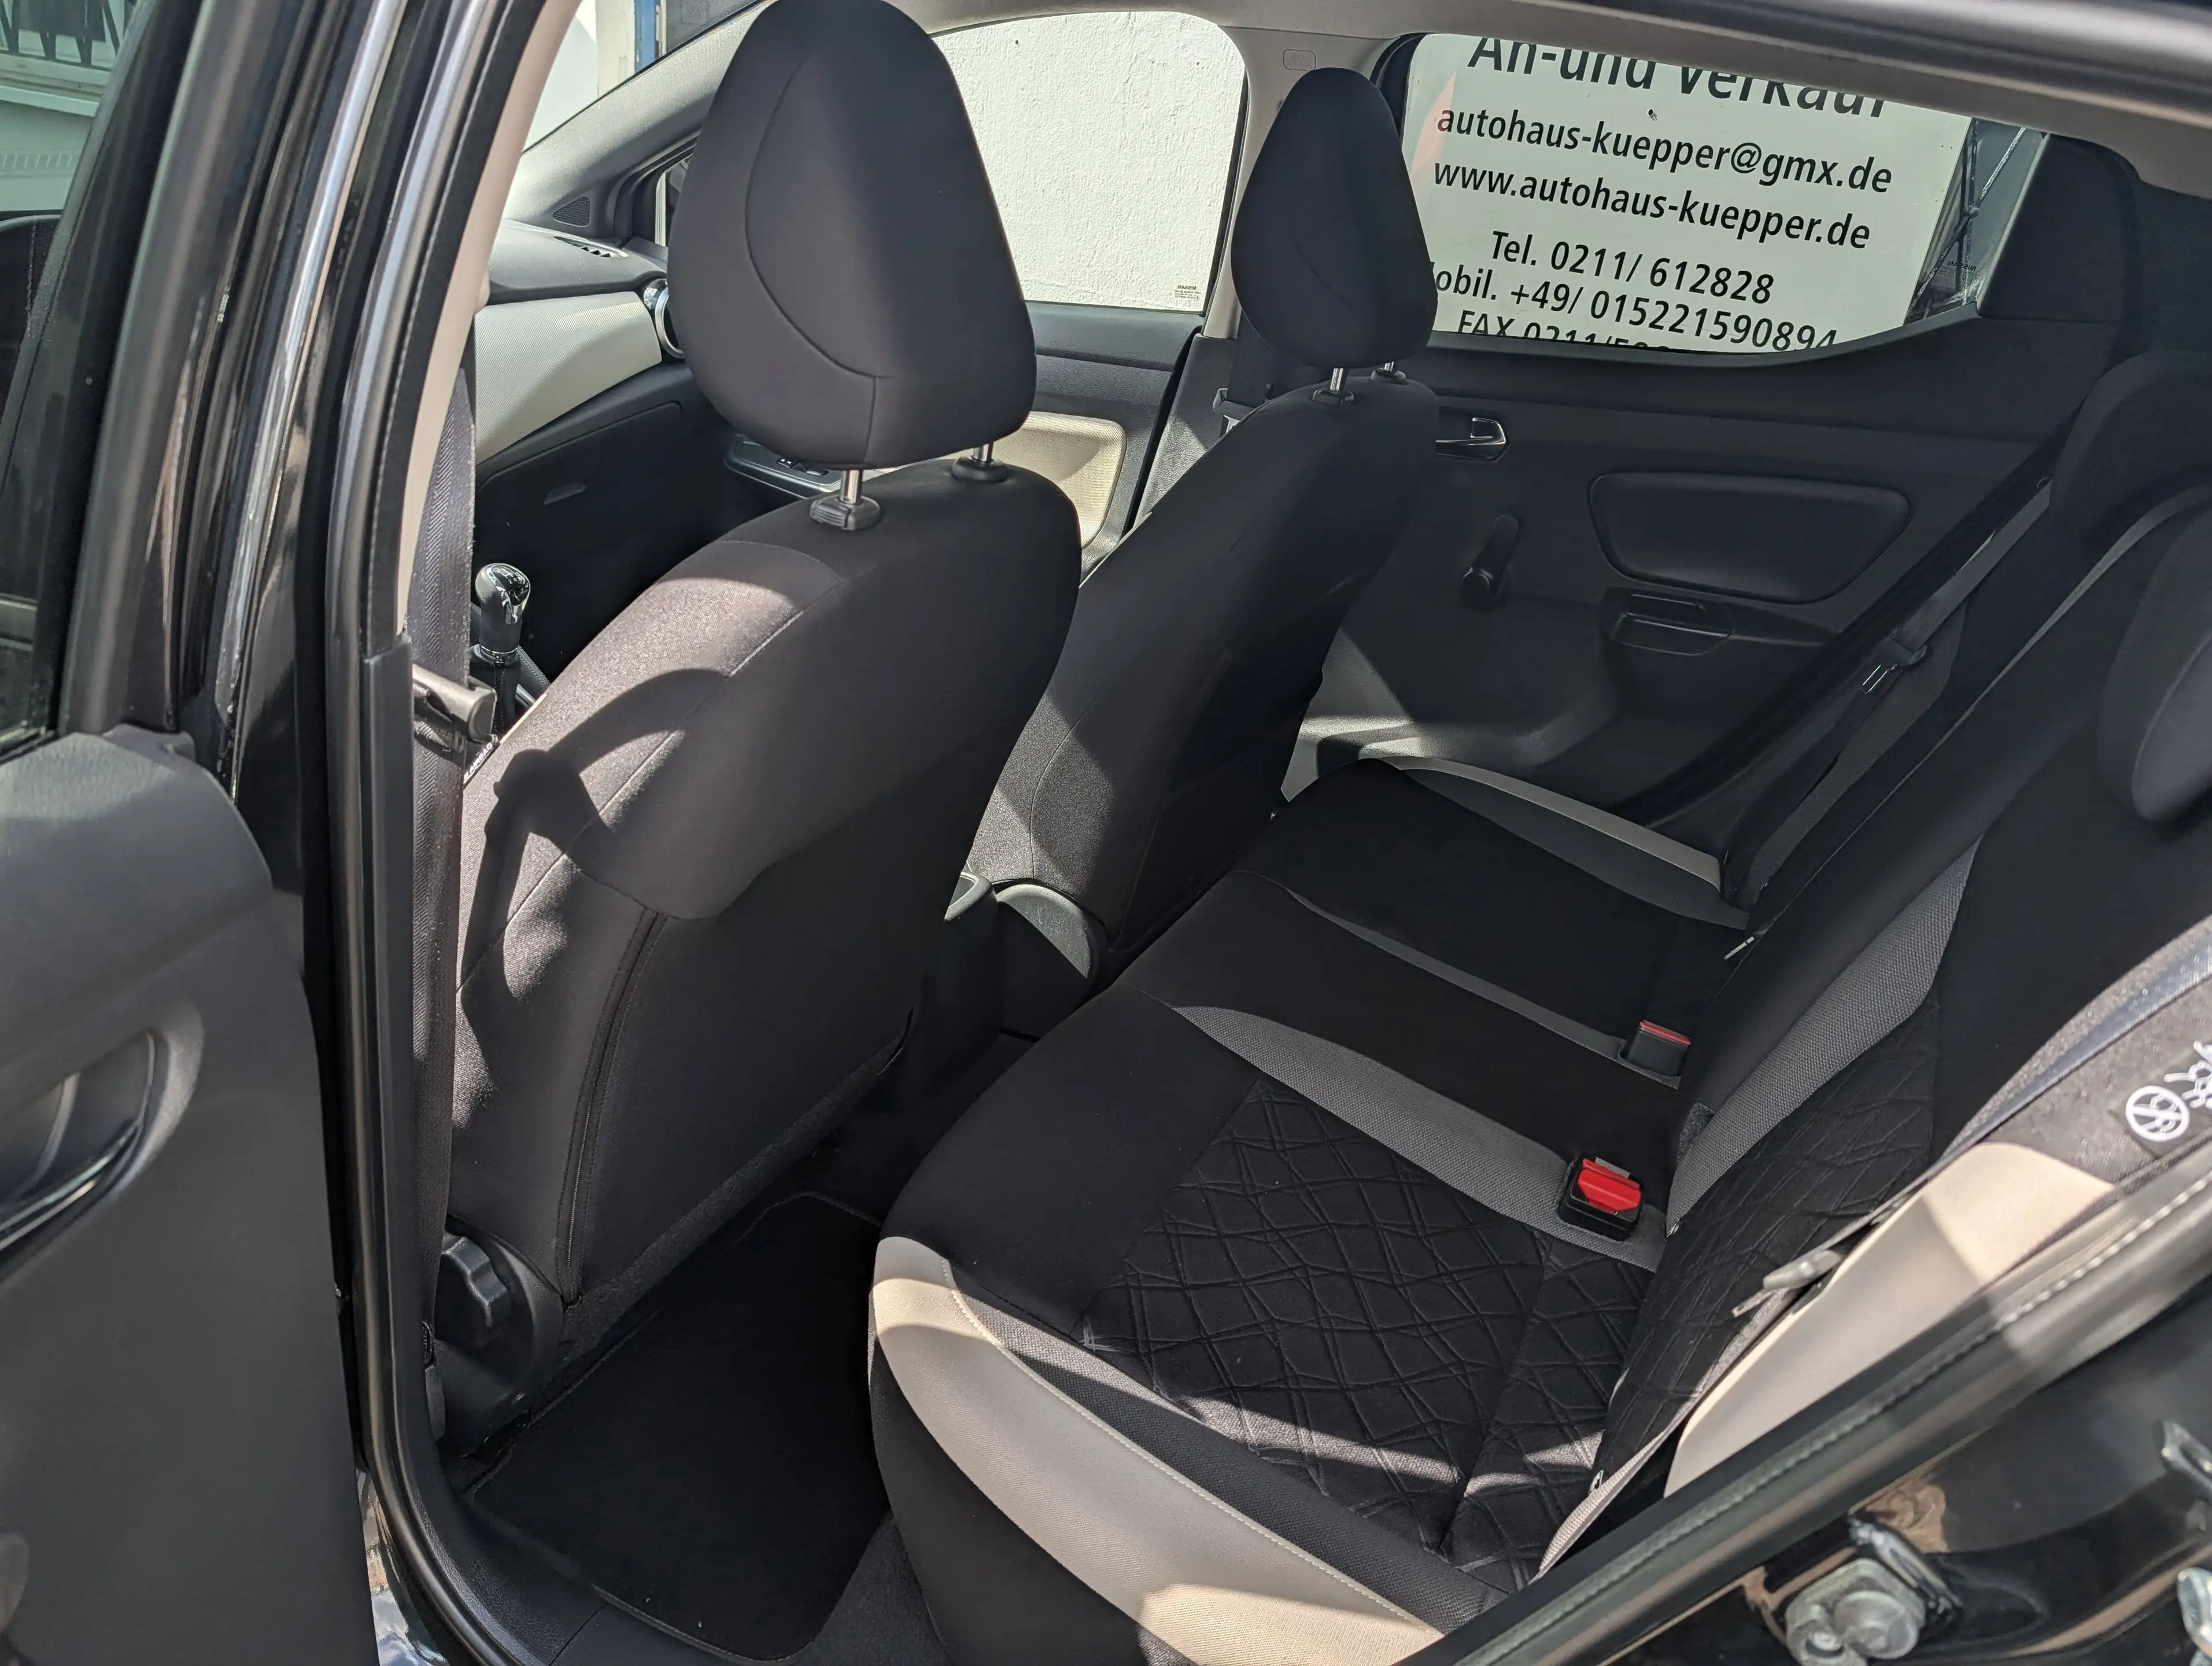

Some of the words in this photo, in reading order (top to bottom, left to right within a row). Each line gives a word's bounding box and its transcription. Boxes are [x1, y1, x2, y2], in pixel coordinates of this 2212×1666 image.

[1467, 36, 1656, 90] An-und
[1437, 109, 1892, 193] autohaus-kuepper@gmx.de
[1435, 163, 1870, 249] www.autohaus-kuepper.de
[1430, 261, 1497, 301] obil.
[1510, 281, 1584, 314] +49/
[1492, 230, 1537, 266] Tel.
[1550, 241, 1644, 282] 0211/
[1650, 257, 1774, 304] 612828
[1457, 309, 1515, 337] FAX
